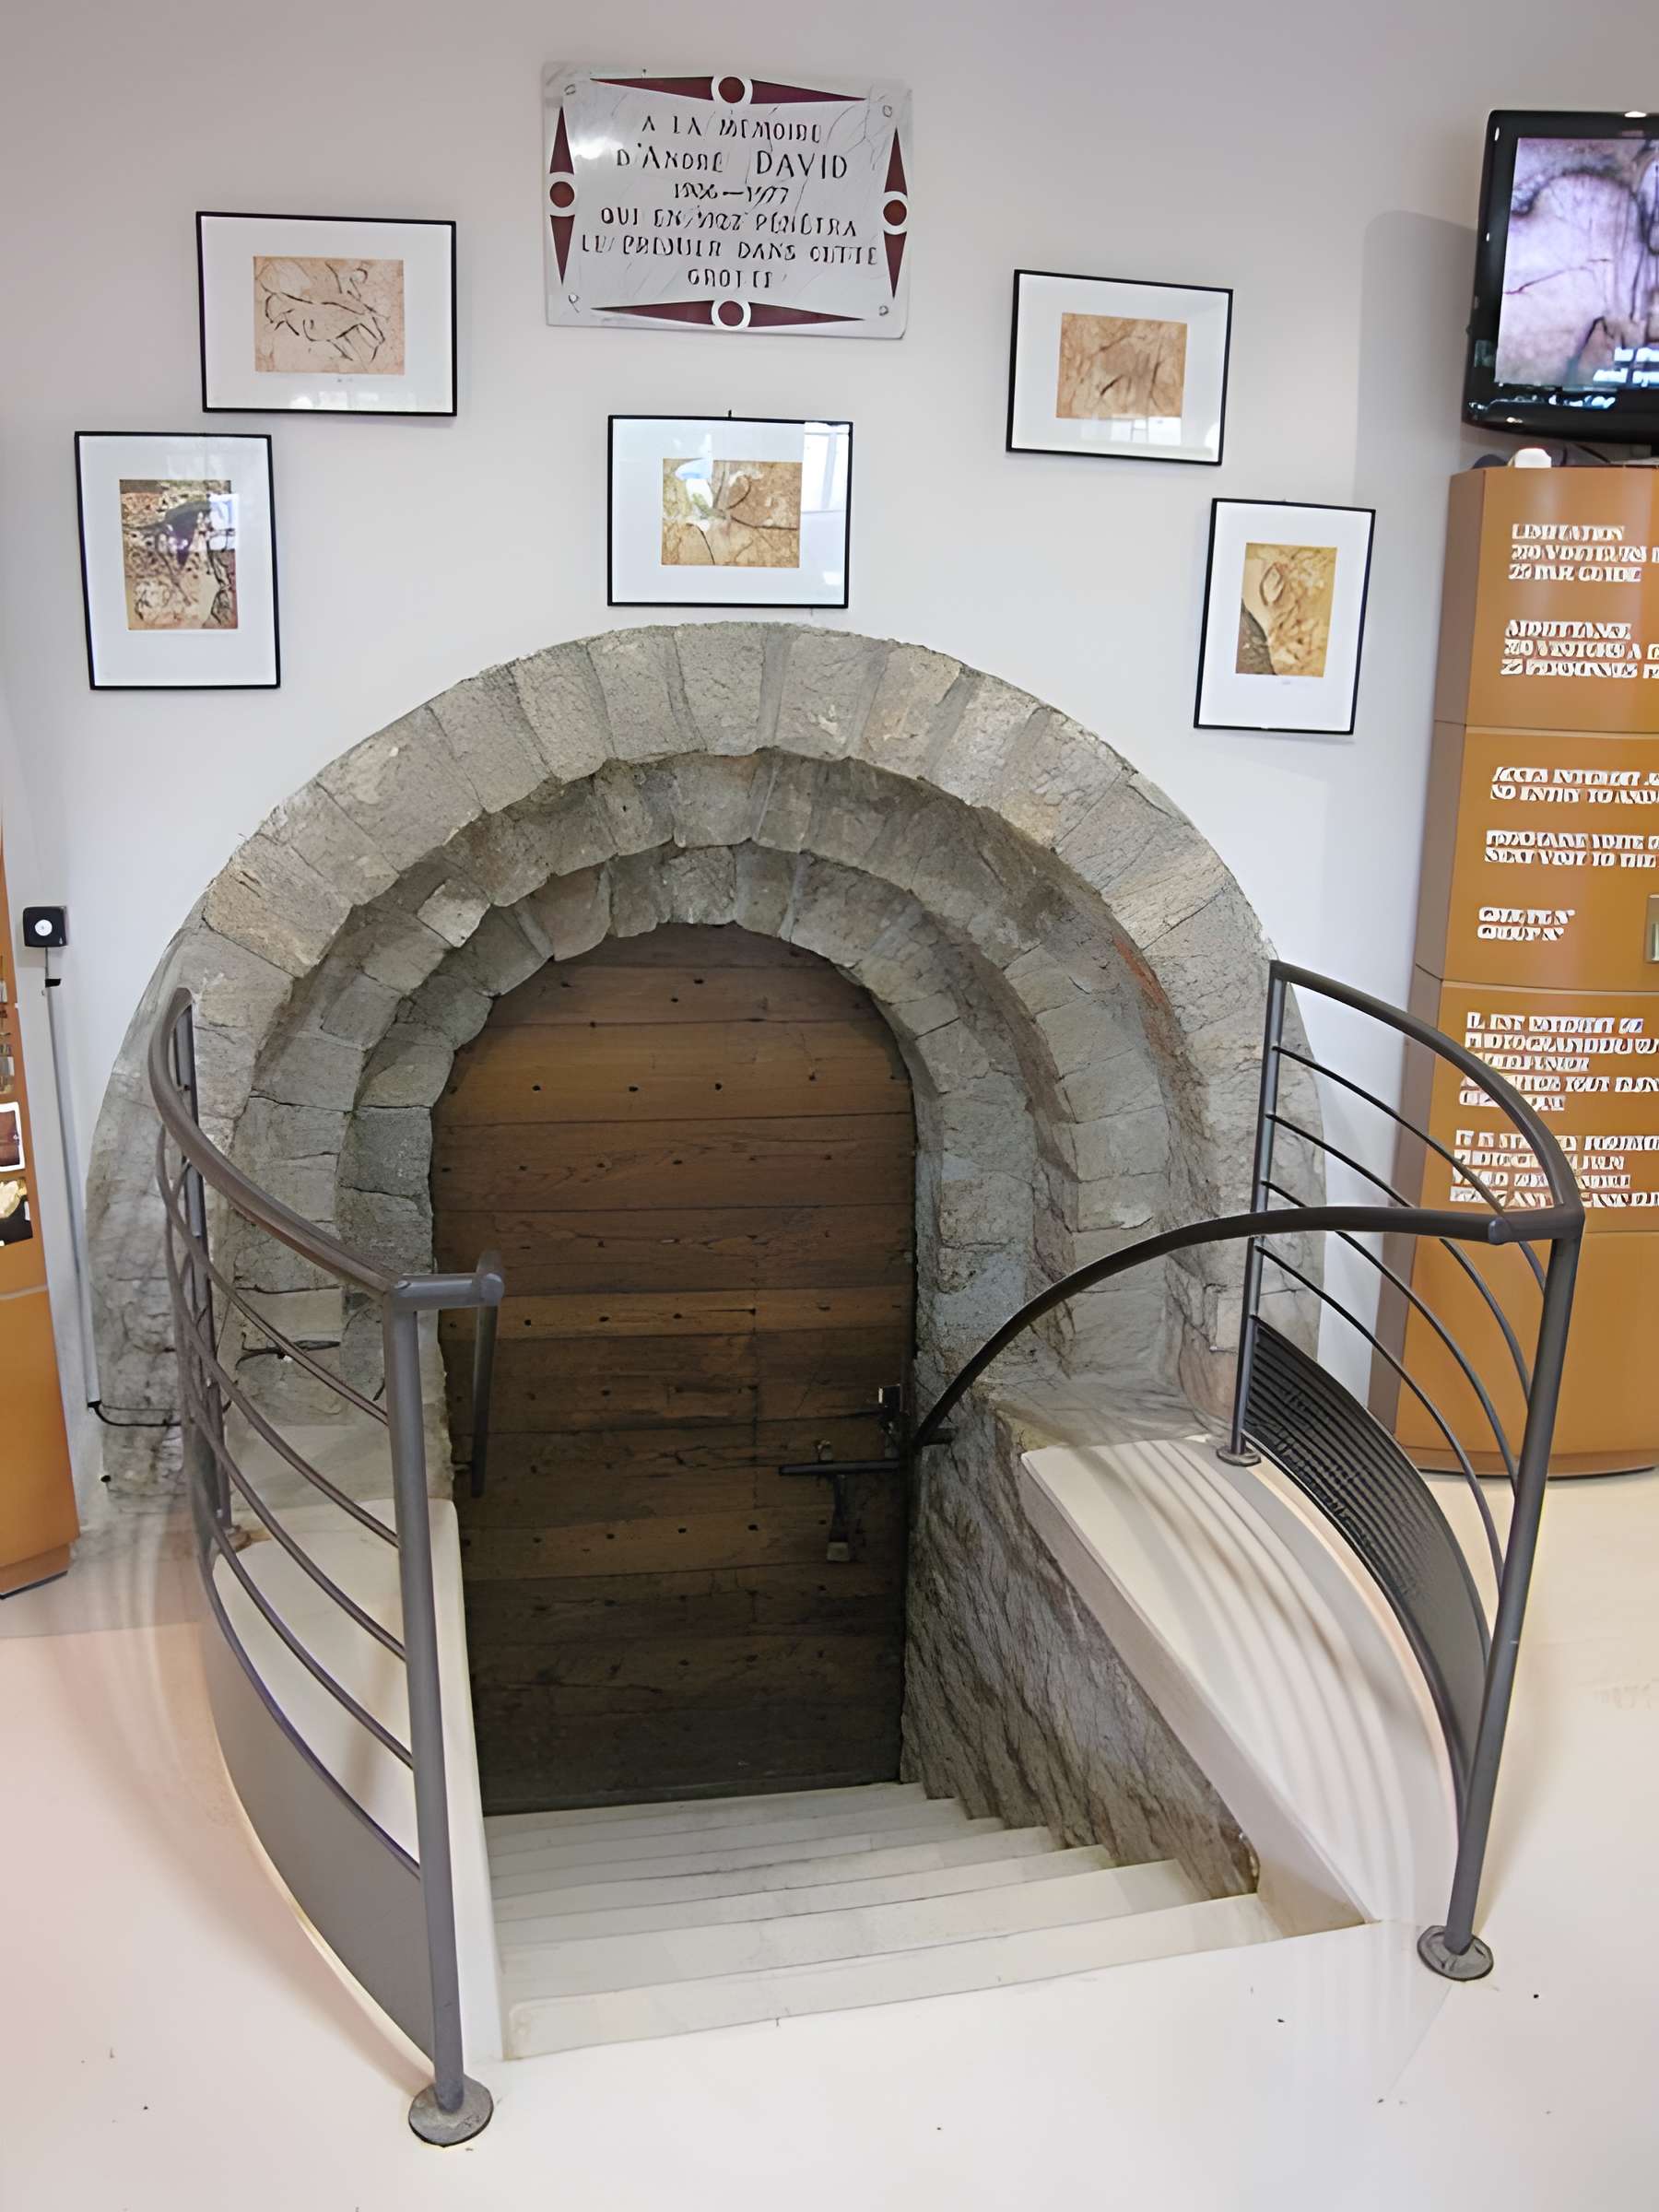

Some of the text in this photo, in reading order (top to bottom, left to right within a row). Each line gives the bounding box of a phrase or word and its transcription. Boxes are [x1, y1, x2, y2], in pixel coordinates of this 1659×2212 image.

[641, 114, 656, 133] A
[673, 115, 701, 136] LA
[757, 150, 847, 180] DAVID
[600, 206, 640, 226] QUI
[653, 208, 682, 229] EN
[737, 241, 796, 261] DANS
